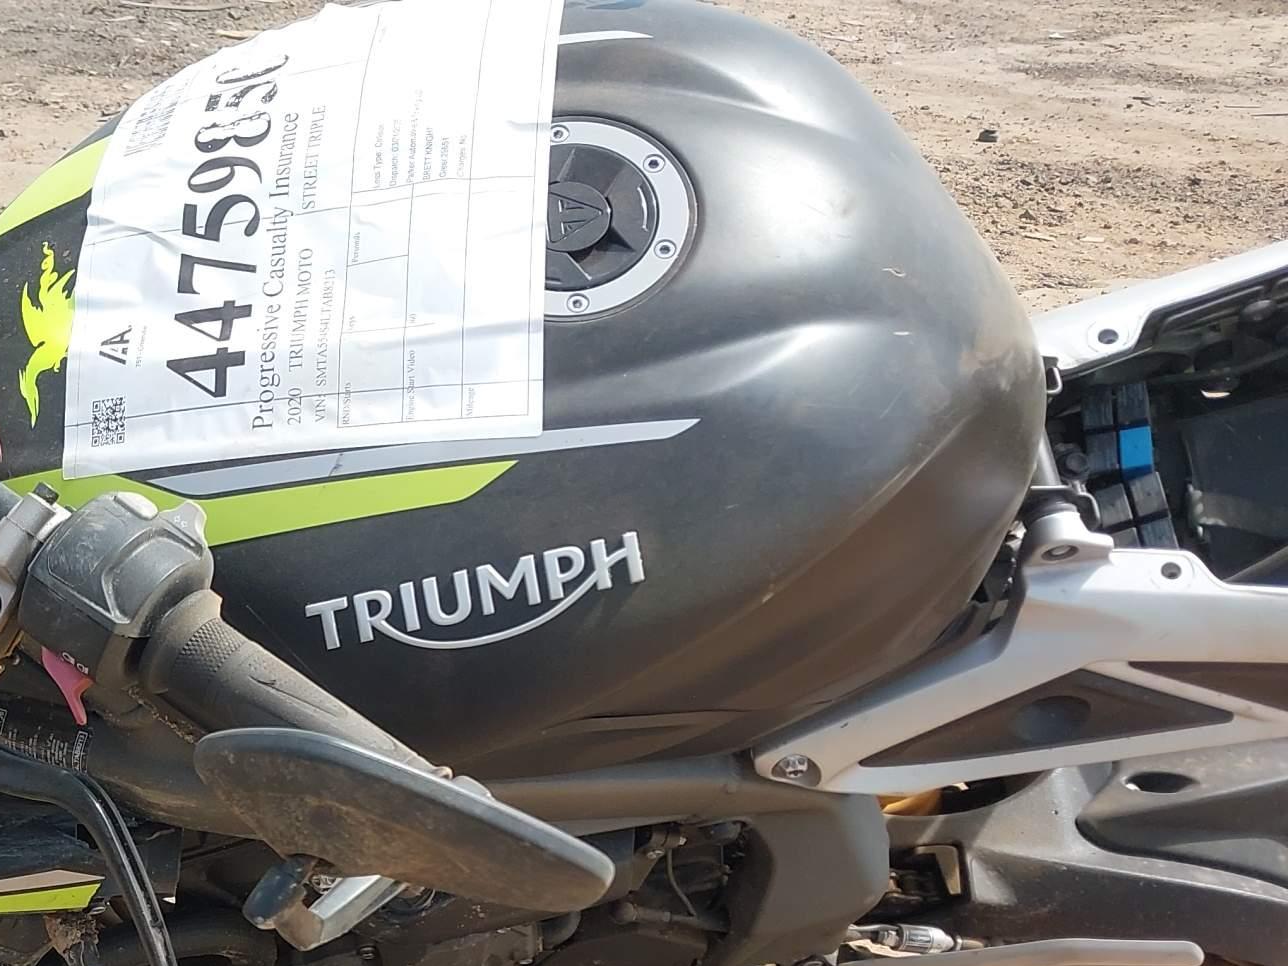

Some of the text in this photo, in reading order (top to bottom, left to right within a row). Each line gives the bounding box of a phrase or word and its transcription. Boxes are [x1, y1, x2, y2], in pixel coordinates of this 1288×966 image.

[253, 112, 299, 431] Progressive Casualty Insurance
[287, 104, 326, 425] 2020 TRIUMPH MOTO STREET TRIPLE
[407, 349, 416, 373] Video
[304, 531, 646, 650] TRIUMPH
